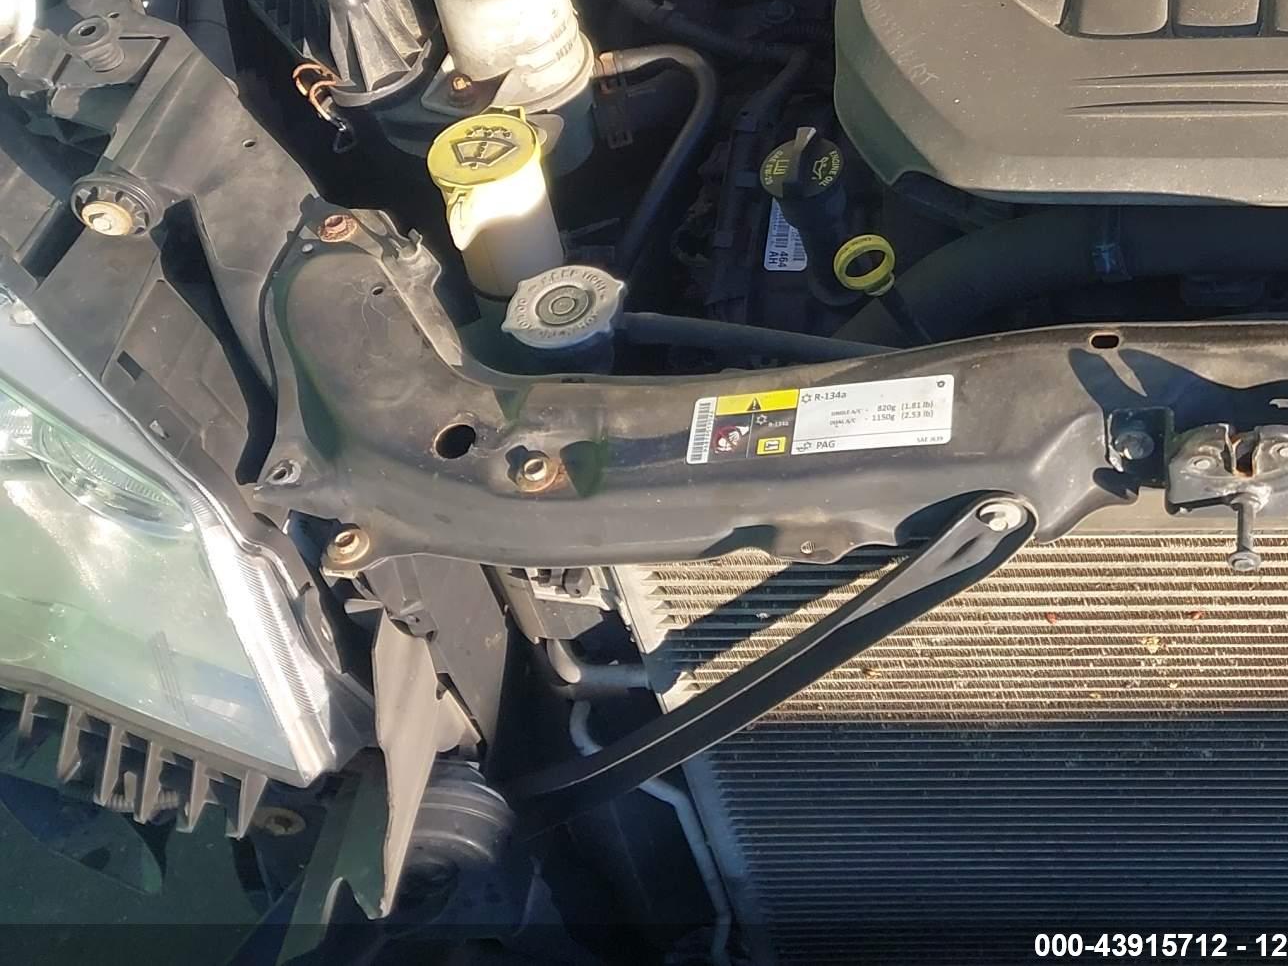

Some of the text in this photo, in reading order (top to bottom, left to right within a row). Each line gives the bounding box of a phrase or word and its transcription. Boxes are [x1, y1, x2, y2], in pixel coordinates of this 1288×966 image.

[818, 150, 841, 187] ENGINE OIL
[768, 251, 779, 264] AH
[778, 251, 789, 268] 464
[814, 391, 847, 402] R-134a
[877, 404, 896, 414] 820g
[872, 413, 896, 422] 1150g
[901, 411, 920, 420] (2.53
[922, 410, 934, 418] lb)
[816, 440, 836, 450] PAG
